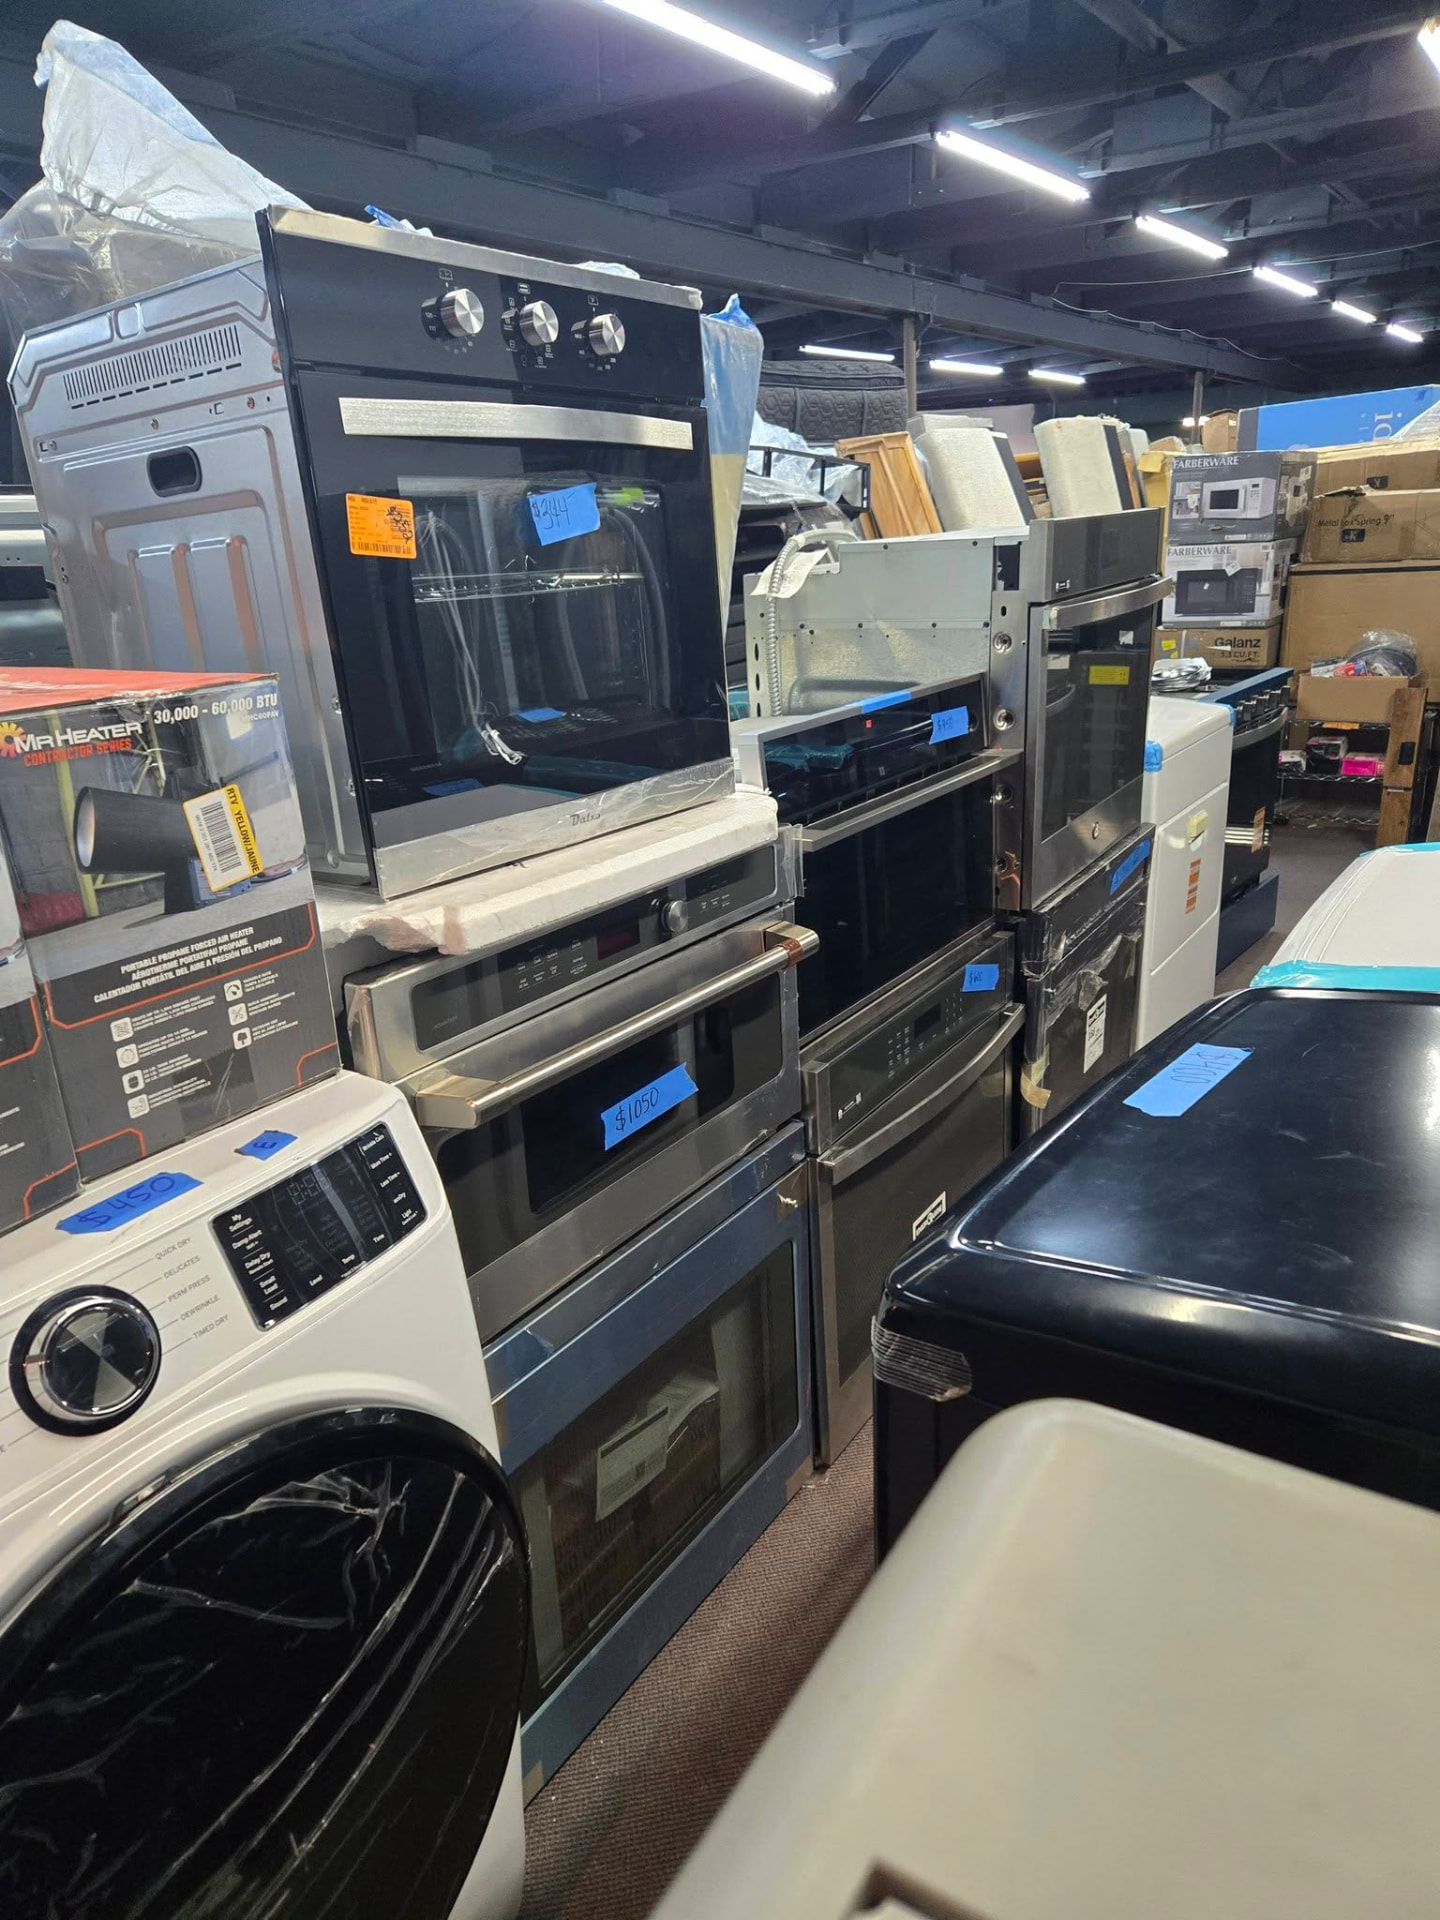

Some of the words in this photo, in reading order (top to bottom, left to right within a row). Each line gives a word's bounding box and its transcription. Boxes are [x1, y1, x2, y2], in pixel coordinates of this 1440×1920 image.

[1173, 455, 1240, 469] FARBERWARE
[1167, 545, 1232, 557] FARBERWARE
[1214, 636, 1261, 648] Galanz
[153, 705, 199, 725] 30,000
[211, 697, 253, 716] 60,000
[256, 693, 278, 709] BTU
[55, 722, 143, 747] HEATER
[23, 743, 94, 767] CONTRACTOR
[96, 737, 132, 755] SERIES
[226, 787, 239, 805] RTV
[234, 810, 261, 873] YELLOW/JAUNE
[120, 957, 158, 974] PORTABLE
[158, 947, 191, 964] PROPANE
[190, 938, 217, 954] FORCED
[217, 934, 230, 945] AIR
[229, 926, 254, 941] HEATER
[218, 937, 249, 954] PROPANE
[93, 980, 142, 1004] CALENTADOR
[175, 967, 190, 978] DEL
[189, 961, 206, 974] AIRE
[206, 959, 213, 968] A
[241, 946, 254, 957] DEL
[253, 936, 283, 952] PROPANO
[615, 1087, 659, 1132] $1050
[74, 1176, 175, 1228] $450
[155, 1246, 177, 1260] QUICK
[176, 1237, 191, 1249] DRY
[163, 1255, 200, 1279] DELICATES
[167, 1287, 188, 1302] PERM
[188, 1274, 211, 1292] PRESS
[180, 1294, 220, 1321] DEWRINKLE
[193, 1323, 215, 1339] TIMED
[215, 1314, 229, 1326] DRY
